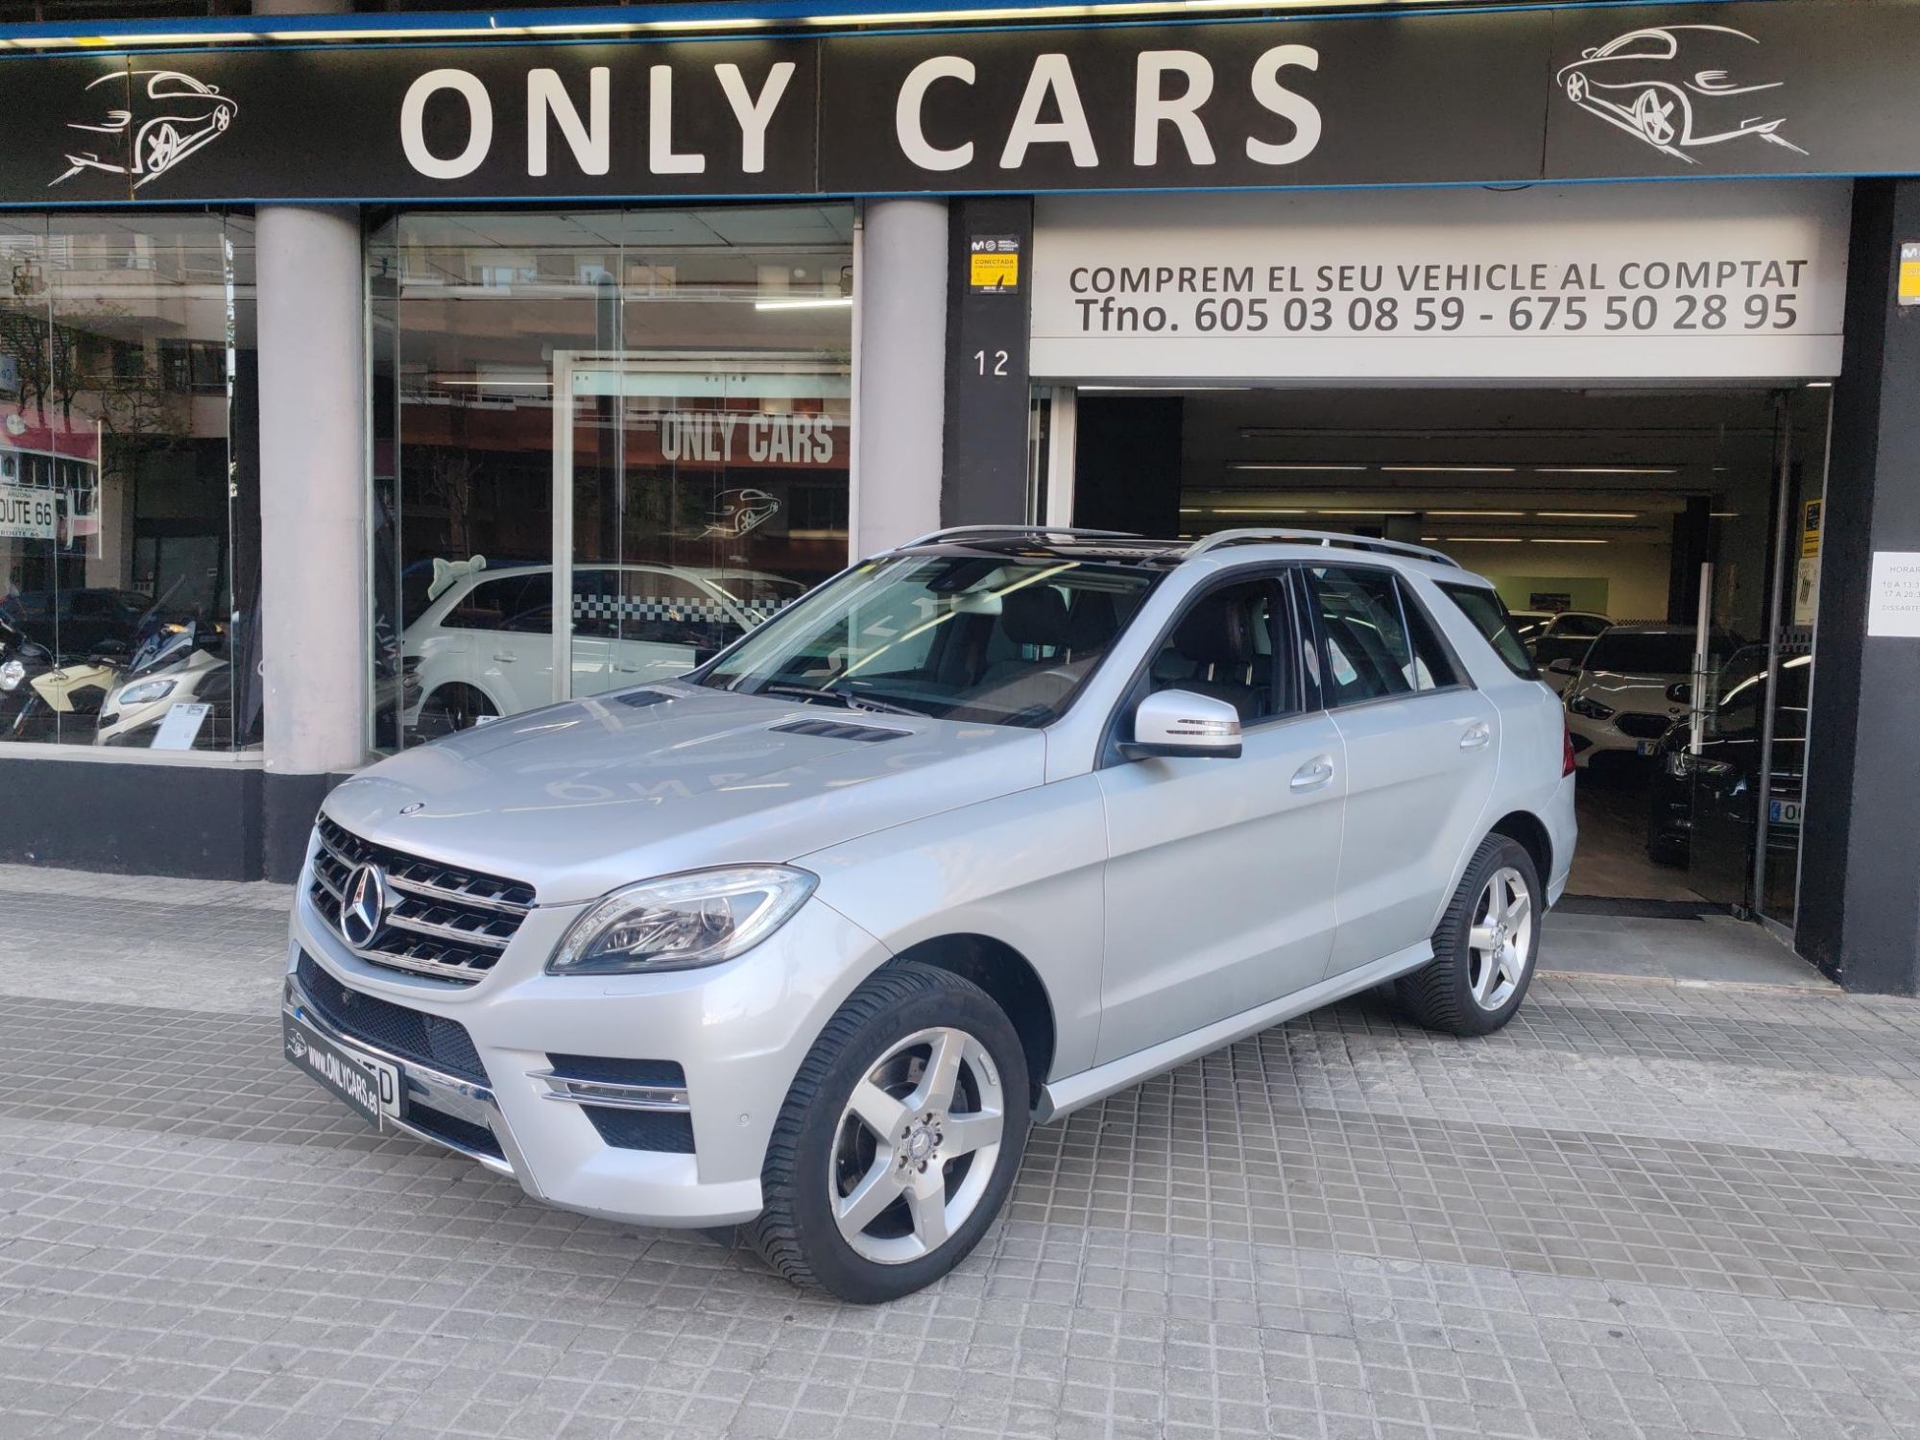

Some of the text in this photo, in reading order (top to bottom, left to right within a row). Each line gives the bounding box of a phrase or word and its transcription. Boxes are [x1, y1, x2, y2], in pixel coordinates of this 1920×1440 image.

[400, 44, 1322, 179] ONLY CARS
[1069, 259, 1808, 293] COMPREM EL SEU VEHICLE AL COMPTAT
[1075, 296, 1178, 332] Tfno.
[1194, 297, 1269, 332] 605
[1283, 297, 1333, 332] 03
[1348, 297, 1399, 332] 08
[1413, 296, 1465, 332] 59
[1508, 295, 1588, 331] 675
[1604, 294, 1658, 331] 50
[1673, 294, 1728, 331] 28
[1743, 293, 1797, 330] 95
[973, 349, 1008, 376] 12
[661, 412, 833, 463] ONLY CARS
[35, 502, 52, 526] 66
